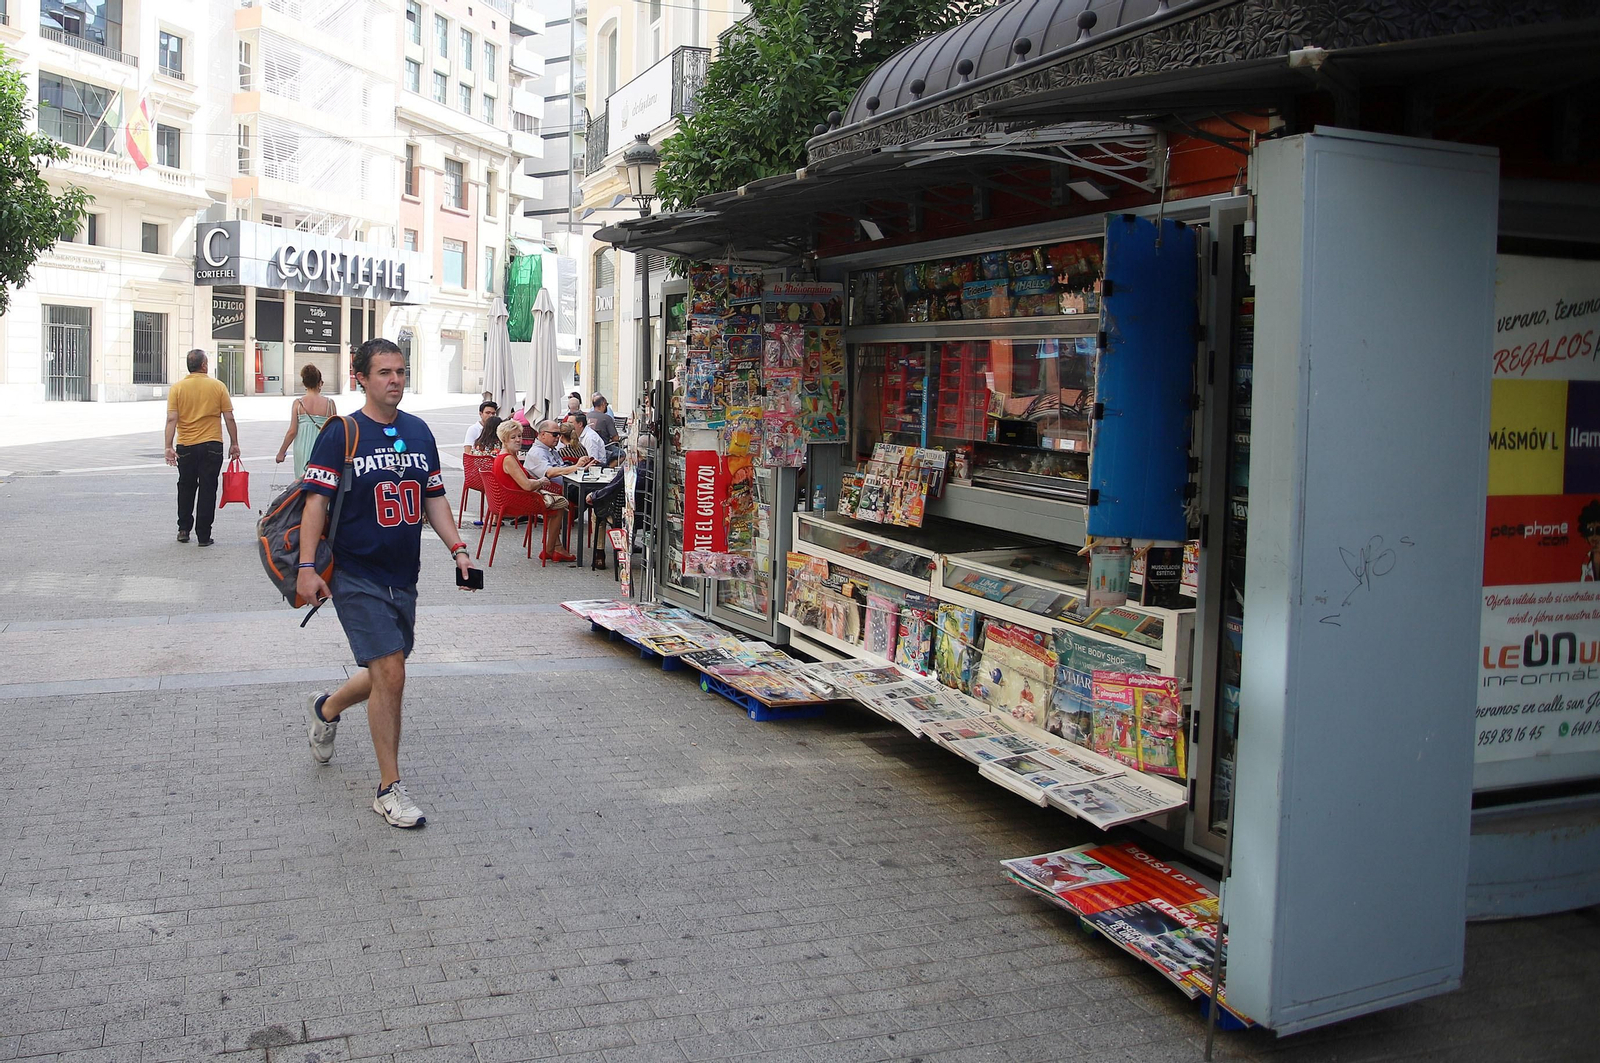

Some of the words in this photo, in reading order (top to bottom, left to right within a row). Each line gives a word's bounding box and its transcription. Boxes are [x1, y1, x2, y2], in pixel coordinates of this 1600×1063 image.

[203, 228, 230, 267] C
[197, 269, 236, 279] CORTEFIEL
[277, 243, 410, 292] CORTEFIEL
[965, 284, 993, 297] Trident
[1017, 279, 1046, 292] HALLS
[1497, 310, 1549, 333] verano,
[1493, 330, 1593, 376] REGALOS
[353, 453, 429, 477] PATRIOTS
[697, 465, 716, 516] GUSTAZO!
[374, 479, 422, 527] 60
[695, 519, 713, 531] EL
[1490, 520, 1569, 540] pepephone
[1538, 536, 1569, 546] .com
[1512, 592, 1537, 605] válida
[1538, 591, 1553, 604] solo
[1554, 594, 1563, 603] si
[1109, 608, 1140, 621] pronto
[1074, 643, 1087, 654] THE
[1088, 648, 1106, 660] BODY
[1106, 653, 1126, 666] SHOP
[1062, 669, 1092, 690] VIAJAR
[1100, 690, 1126, 700] playmobil
[1521, 703, 1536, 714] en
[1537, 694, 1564, 713] calle
[1566, 699, 1585, 711] san
[1477, 729, 1498, 747] 959
[1498, 728, 1513, 744] 83
[1514, 726, 1528, 742] 16
[1528, 725, 1545, 741] 45
[1571, 720, 1593, 737] 640
[1125, 847, 1172, 874] BOLSA
[1171, 873, 1196, 886] DE
